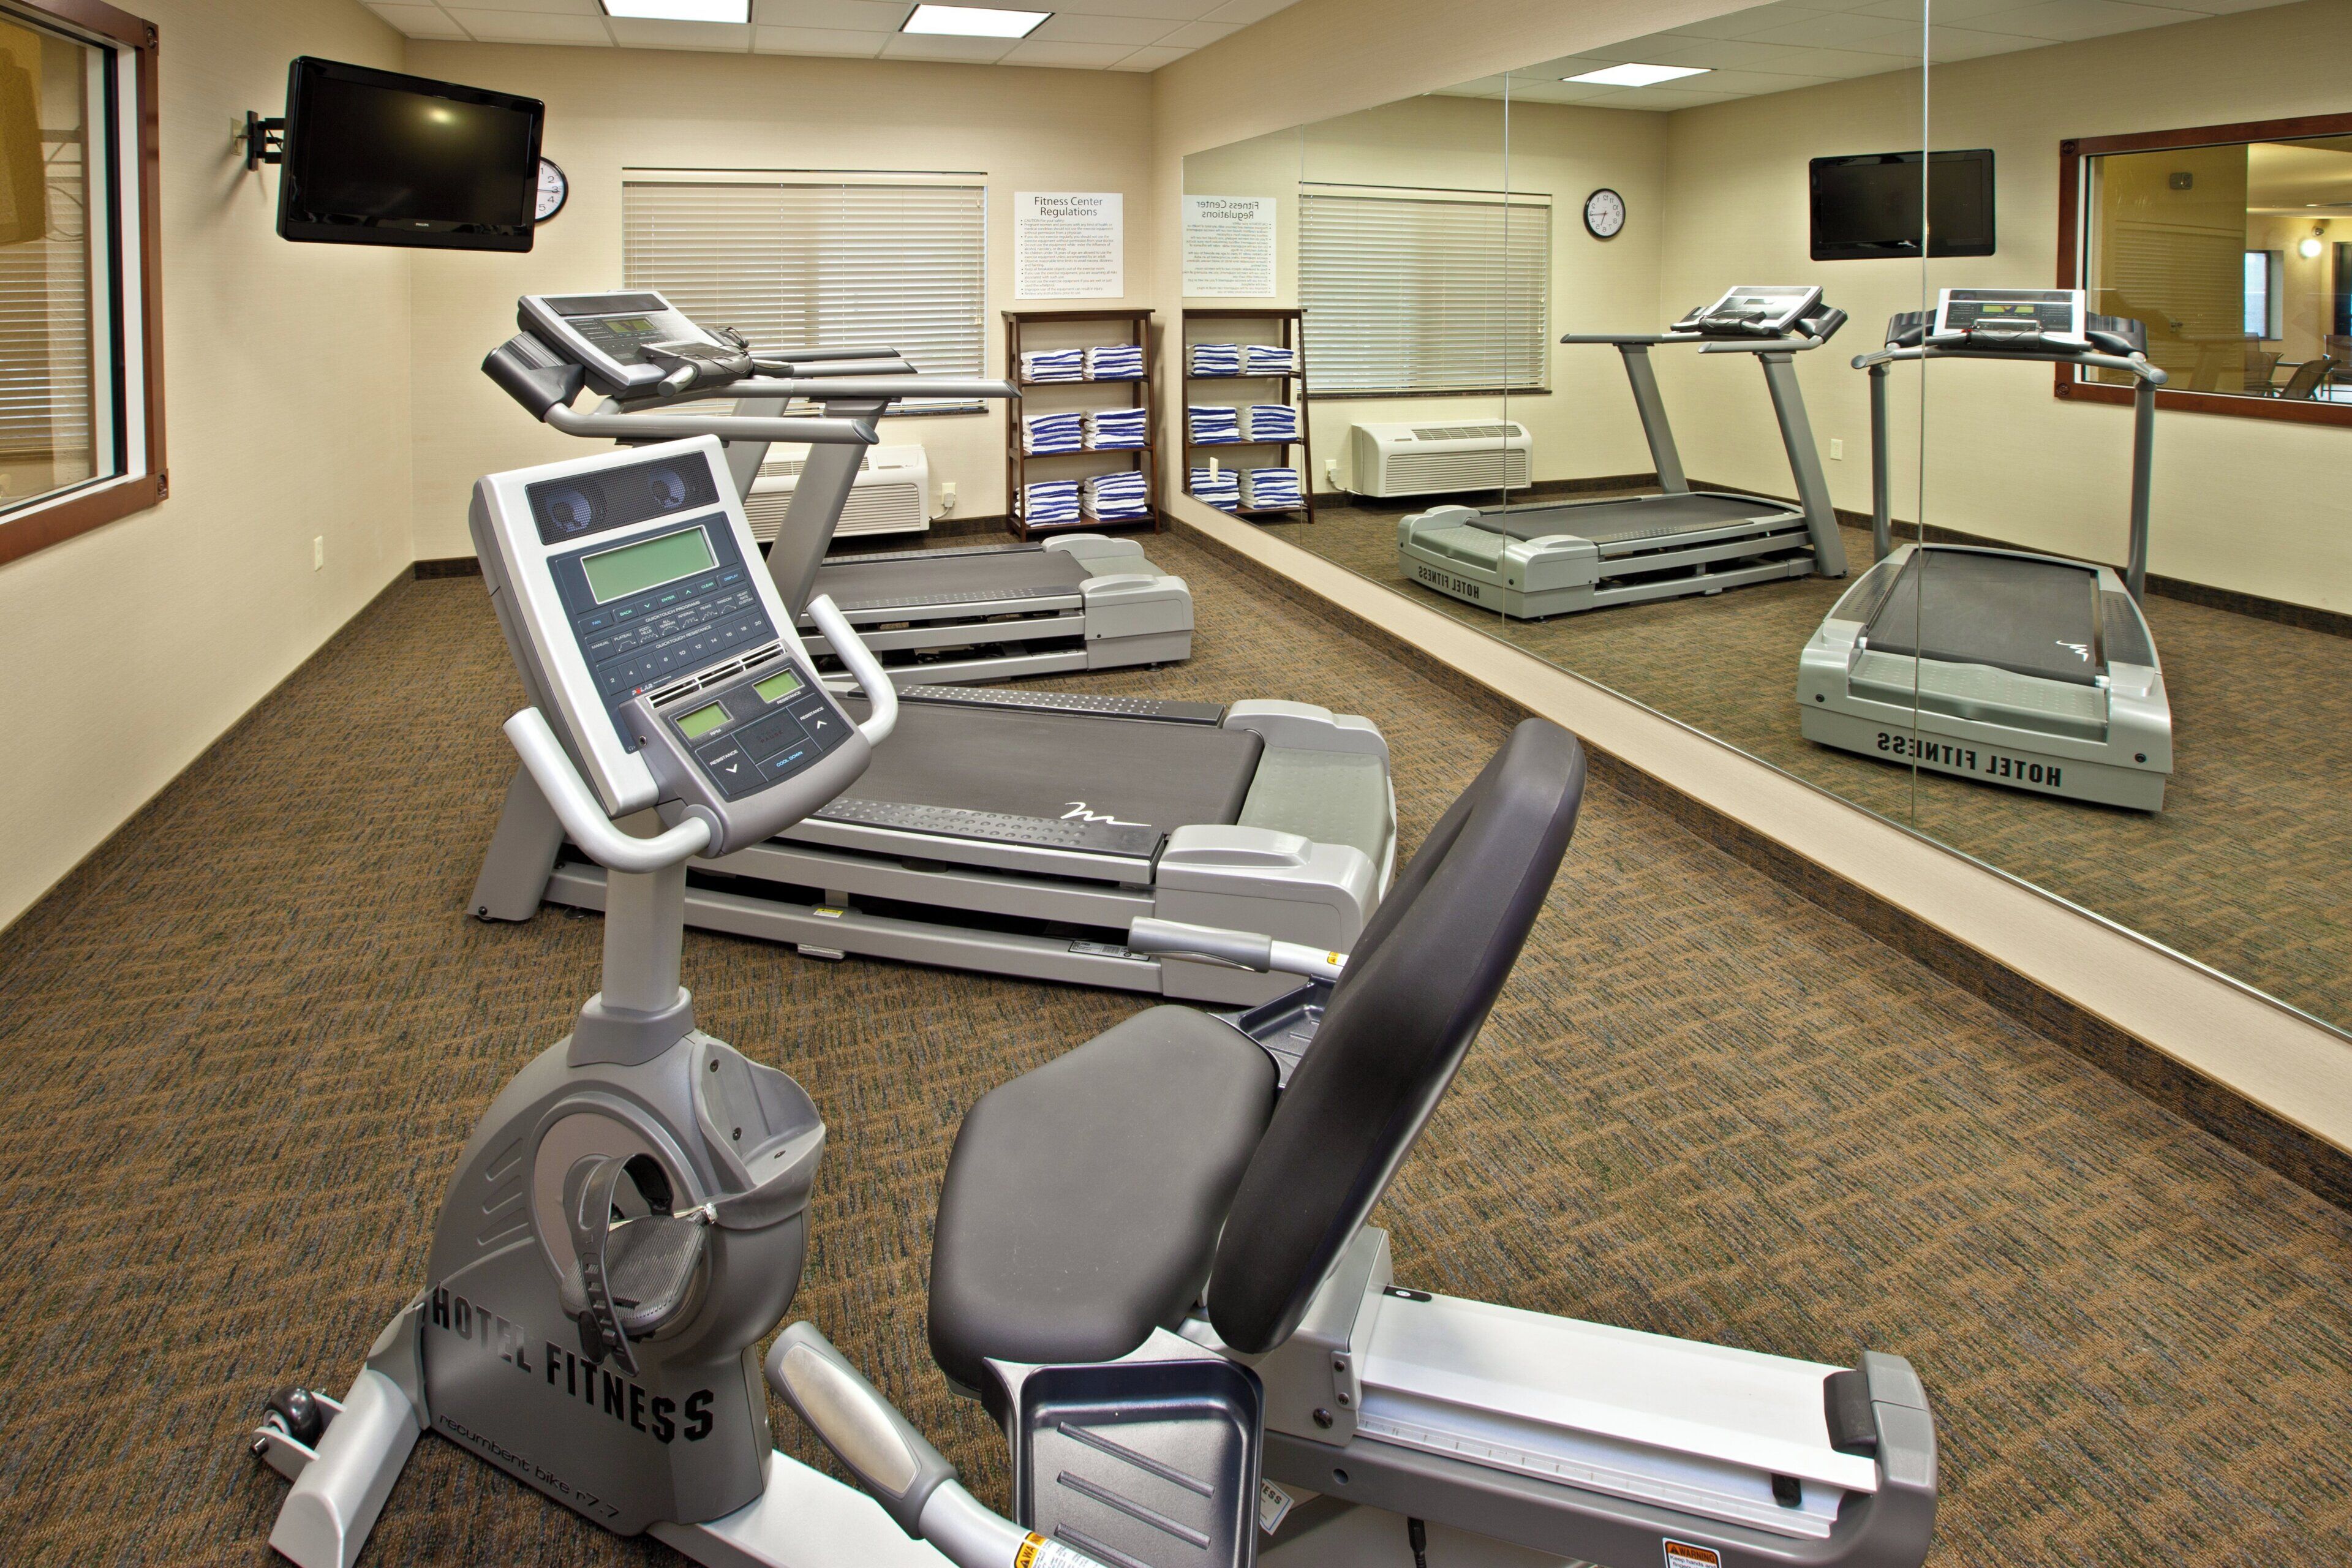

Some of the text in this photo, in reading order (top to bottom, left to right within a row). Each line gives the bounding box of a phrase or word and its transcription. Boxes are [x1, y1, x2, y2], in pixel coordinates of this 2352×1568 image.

[1035, 197, 1103, 205] Fitness Center
[1040, 207, 1097, 218] Regulations
[645, 600, 701, 622] QUICKTOUCH PROGRAMS
[677, 610, 695, 619] INTERVAL
[614, 631, 632, 641] PLATEAU
[655, 625, 712, 649] QUICKTOUCH RESISTANCE
[591, 640, 609, 650] MANUAL
[632, 683, 653, 696] POLAR
[777, 690, 802, 704] RESISTANCE
[799, 706, 824, 721] RESISTANCE
[710, 728, 722, 736] RPM
[709, 749, 739, 766] RESISTANCE
[776, 750, 803, 767] COOL DOWN
[433, 1281, 714, 1444] HOTEL FITNESS
[439, 1414, 620, 1519] recumbent bike r7.7
[1679, 1547, 1715, 1562] WARNING
[1686, 1558, 1704, 1567] hands
